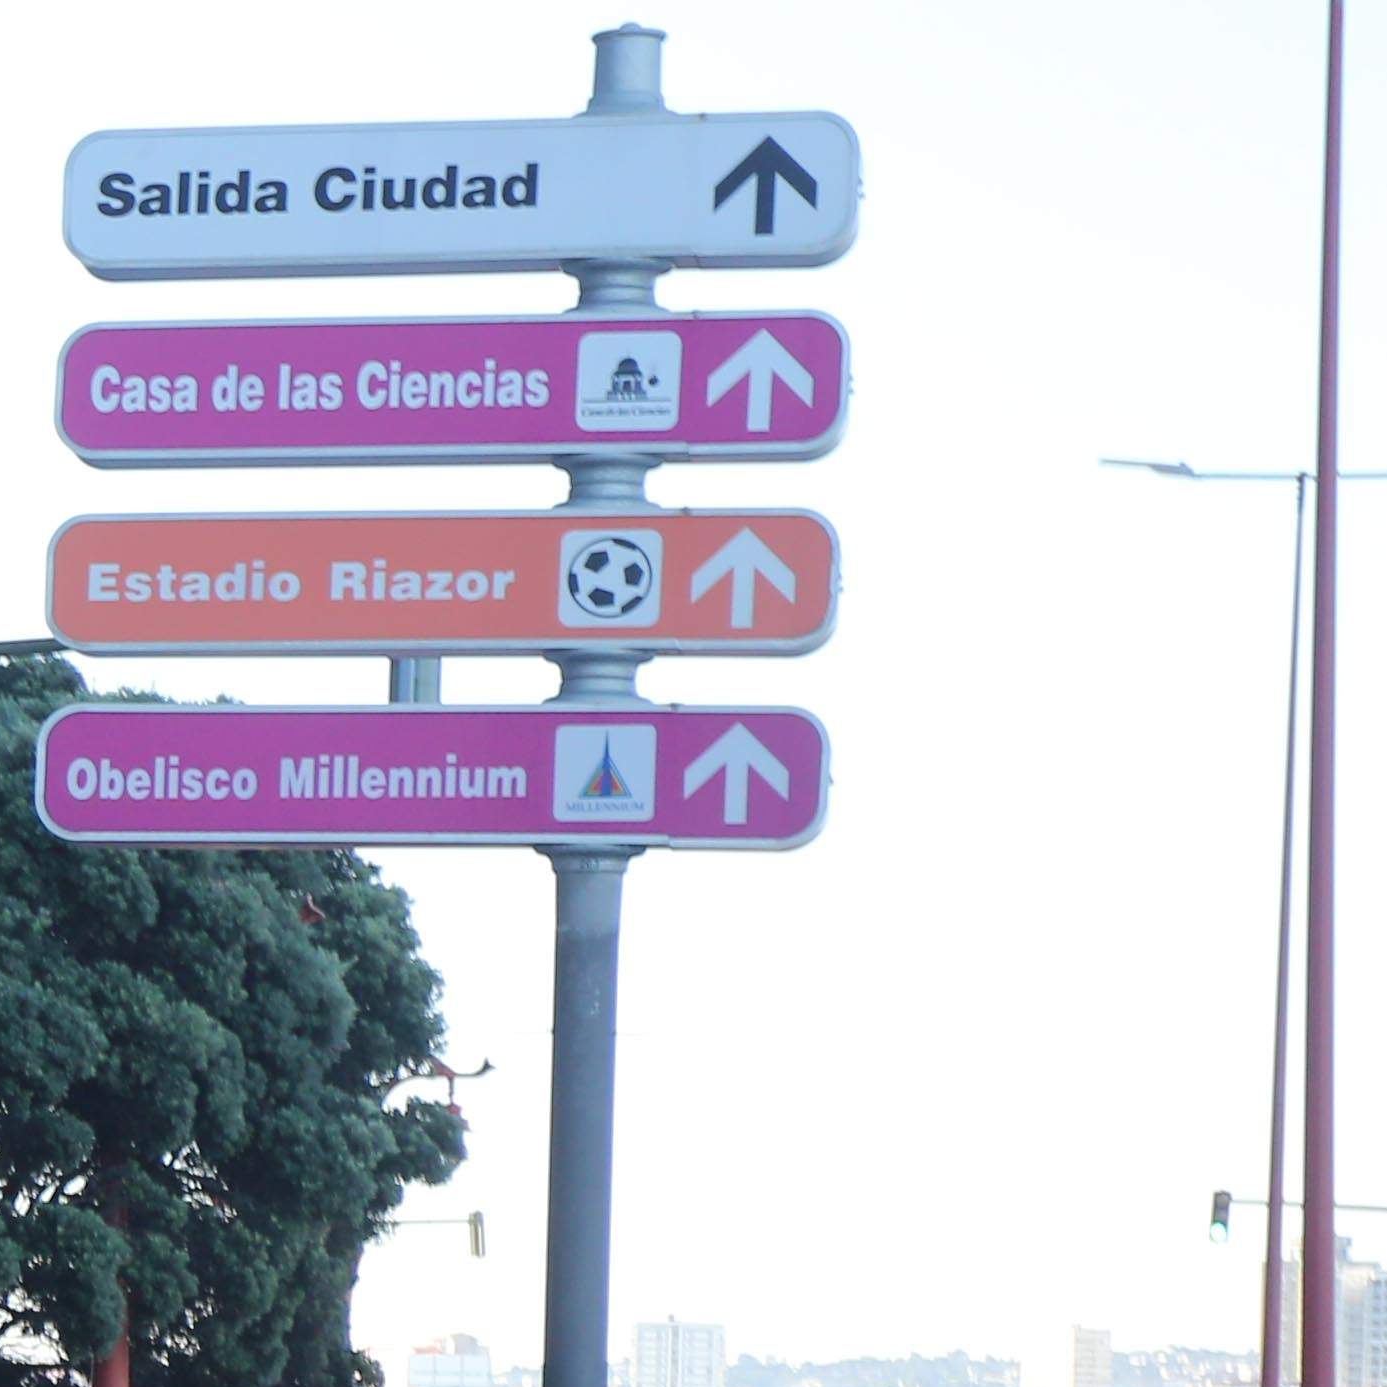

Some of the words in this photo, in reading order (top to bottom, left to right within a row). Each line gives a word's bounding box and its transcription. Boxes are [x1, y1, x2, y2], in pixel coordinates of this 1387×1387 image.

[96, 170, 288, 217] Salida
[313, 162, 539, 213] Ciudad
[90, 364, 199, 414] Casa
[212, 363, 265, 413] de
[278, 362, 344, 411] las
[357, 358, 550, 411] Ciencias
[86, 558, 302, 604] Estadio
[329, 557, 516, 602] Riazor
[66, 755, 258, 801] Obelisco
[279, 753, 528, 799] Millennium
